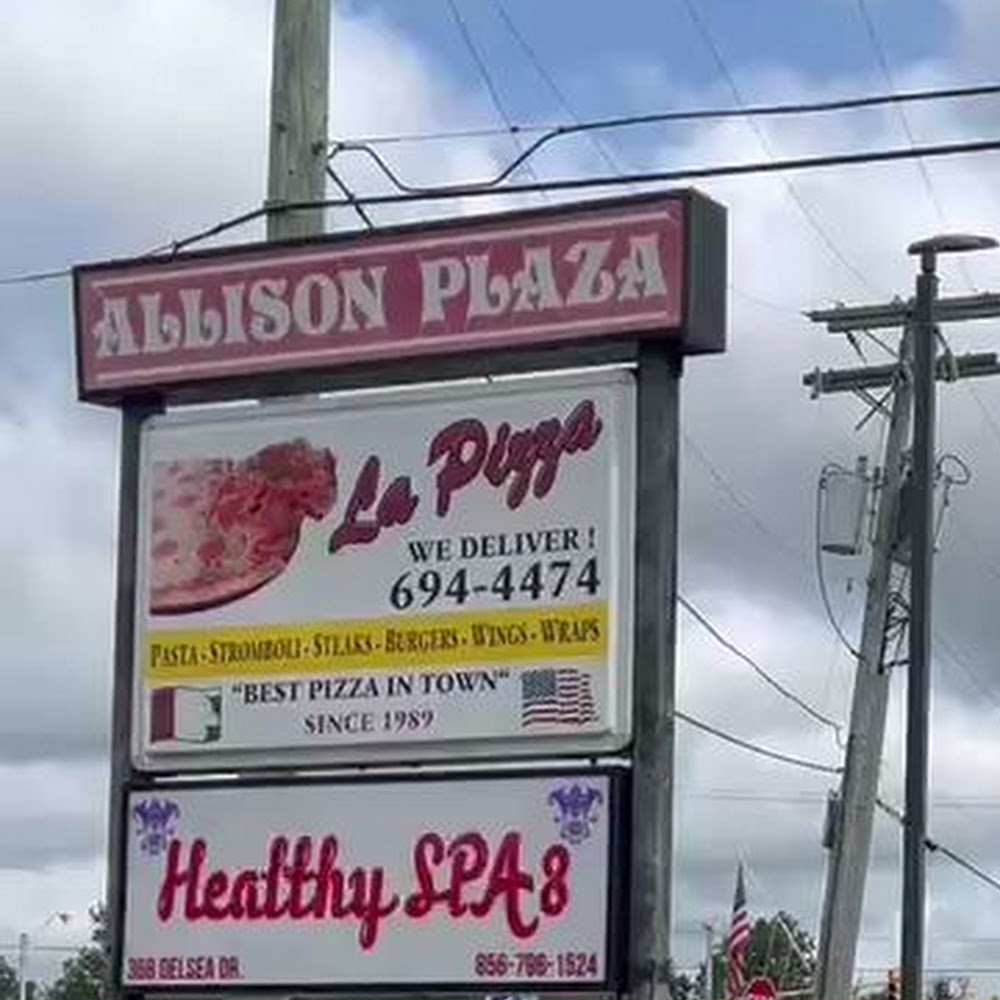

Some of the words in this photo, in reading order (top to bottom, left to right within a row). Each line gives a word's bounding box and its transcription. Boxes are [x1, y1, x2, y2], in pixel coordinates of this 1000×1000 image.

[92, 265, 387, 358] ALLISON
[420, 233, 668, 323] PLAZA
[328, 455, 420, 554] La
[427, 399, 603, 518] Pizza
[408, 540, 451, 562] WE
[389, 557, 600, 610] 694-4474
[150, 644, 199, 667] PASTA
[471, 621, 528, 647] WINGS
[539, 617, 600, 643] WRAPS
[309, 676, 379, 700] PIZZA
[387, 675, 412, 697] IN
[303, 713, 375, 735] SINCE
[384, 710, 434, 731] 1989
[156, 834, 401, 951] Healthy
[402, 830, 540, 939] SPA
